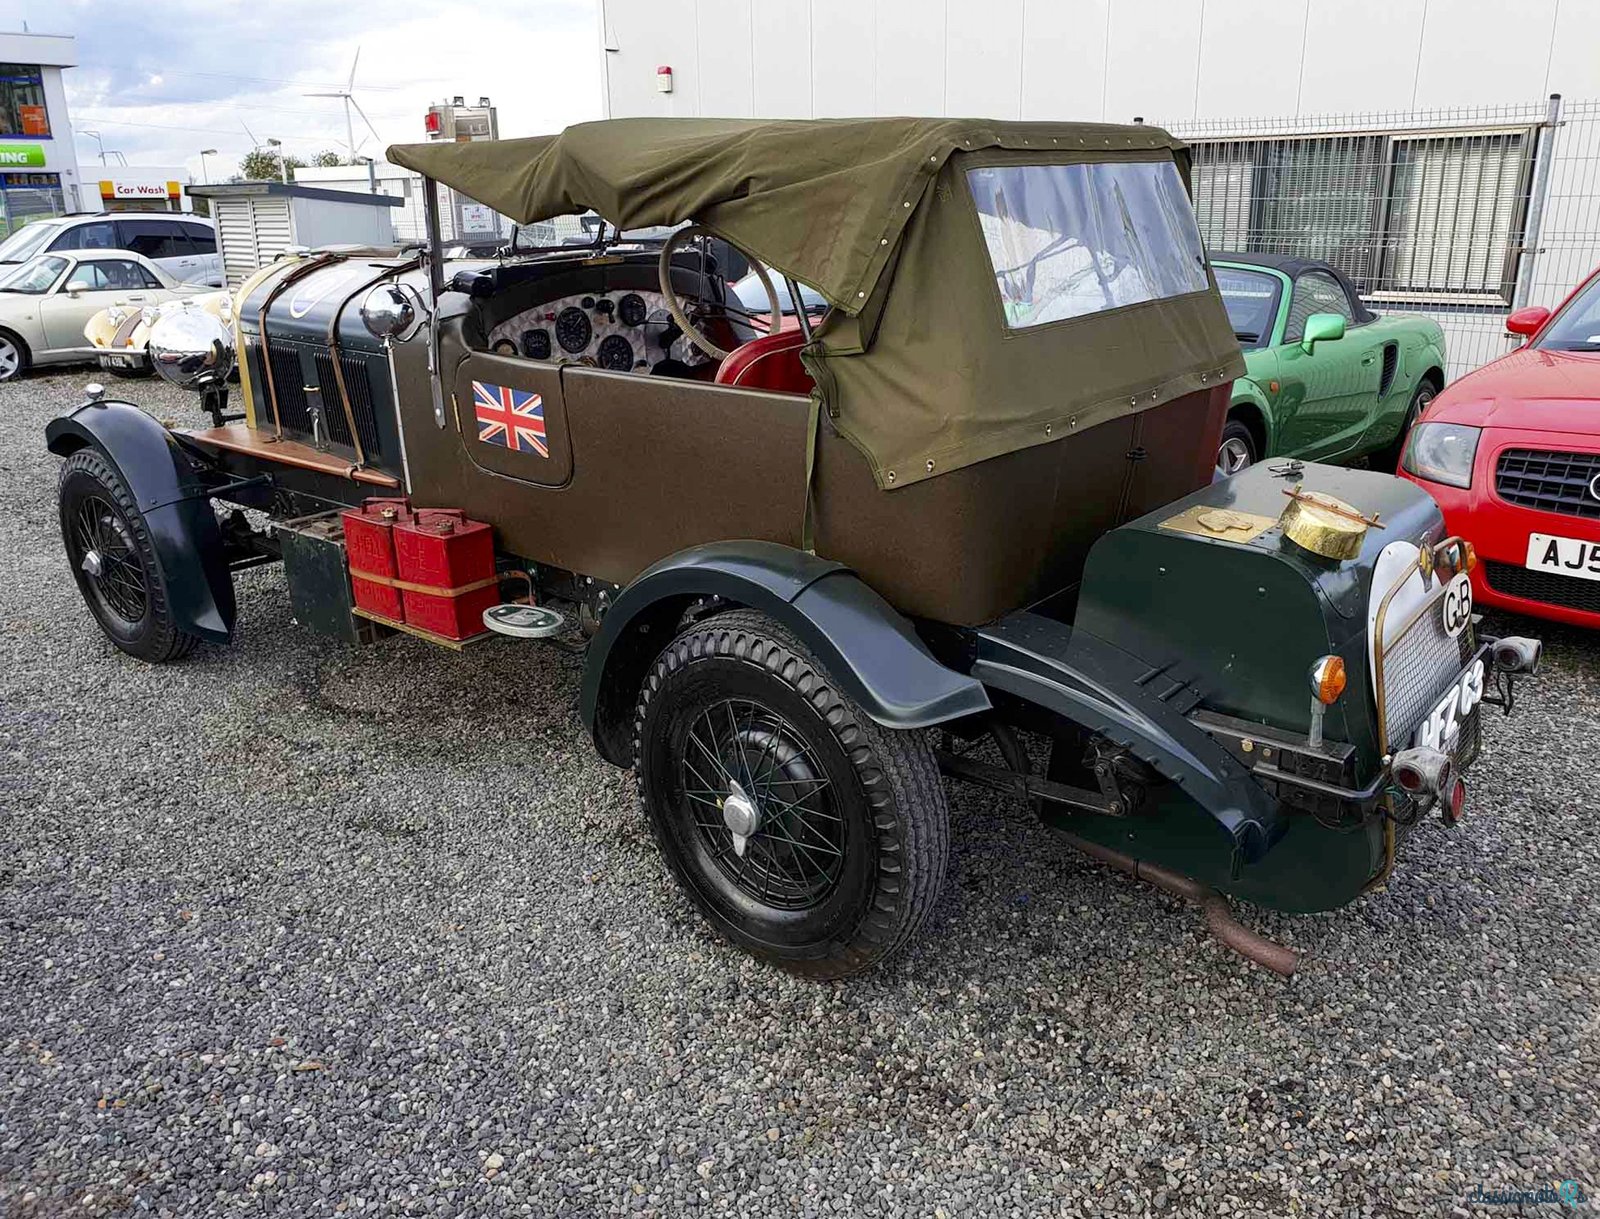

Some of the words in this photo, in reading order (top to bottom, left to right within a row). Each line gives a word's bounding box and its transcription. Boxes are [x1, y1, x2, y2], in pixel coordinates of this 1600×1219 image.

[117, 186, 134, 194] Car
[137, 186, 165, 194] Wash
[1446, 579, 1470, 632] GB
